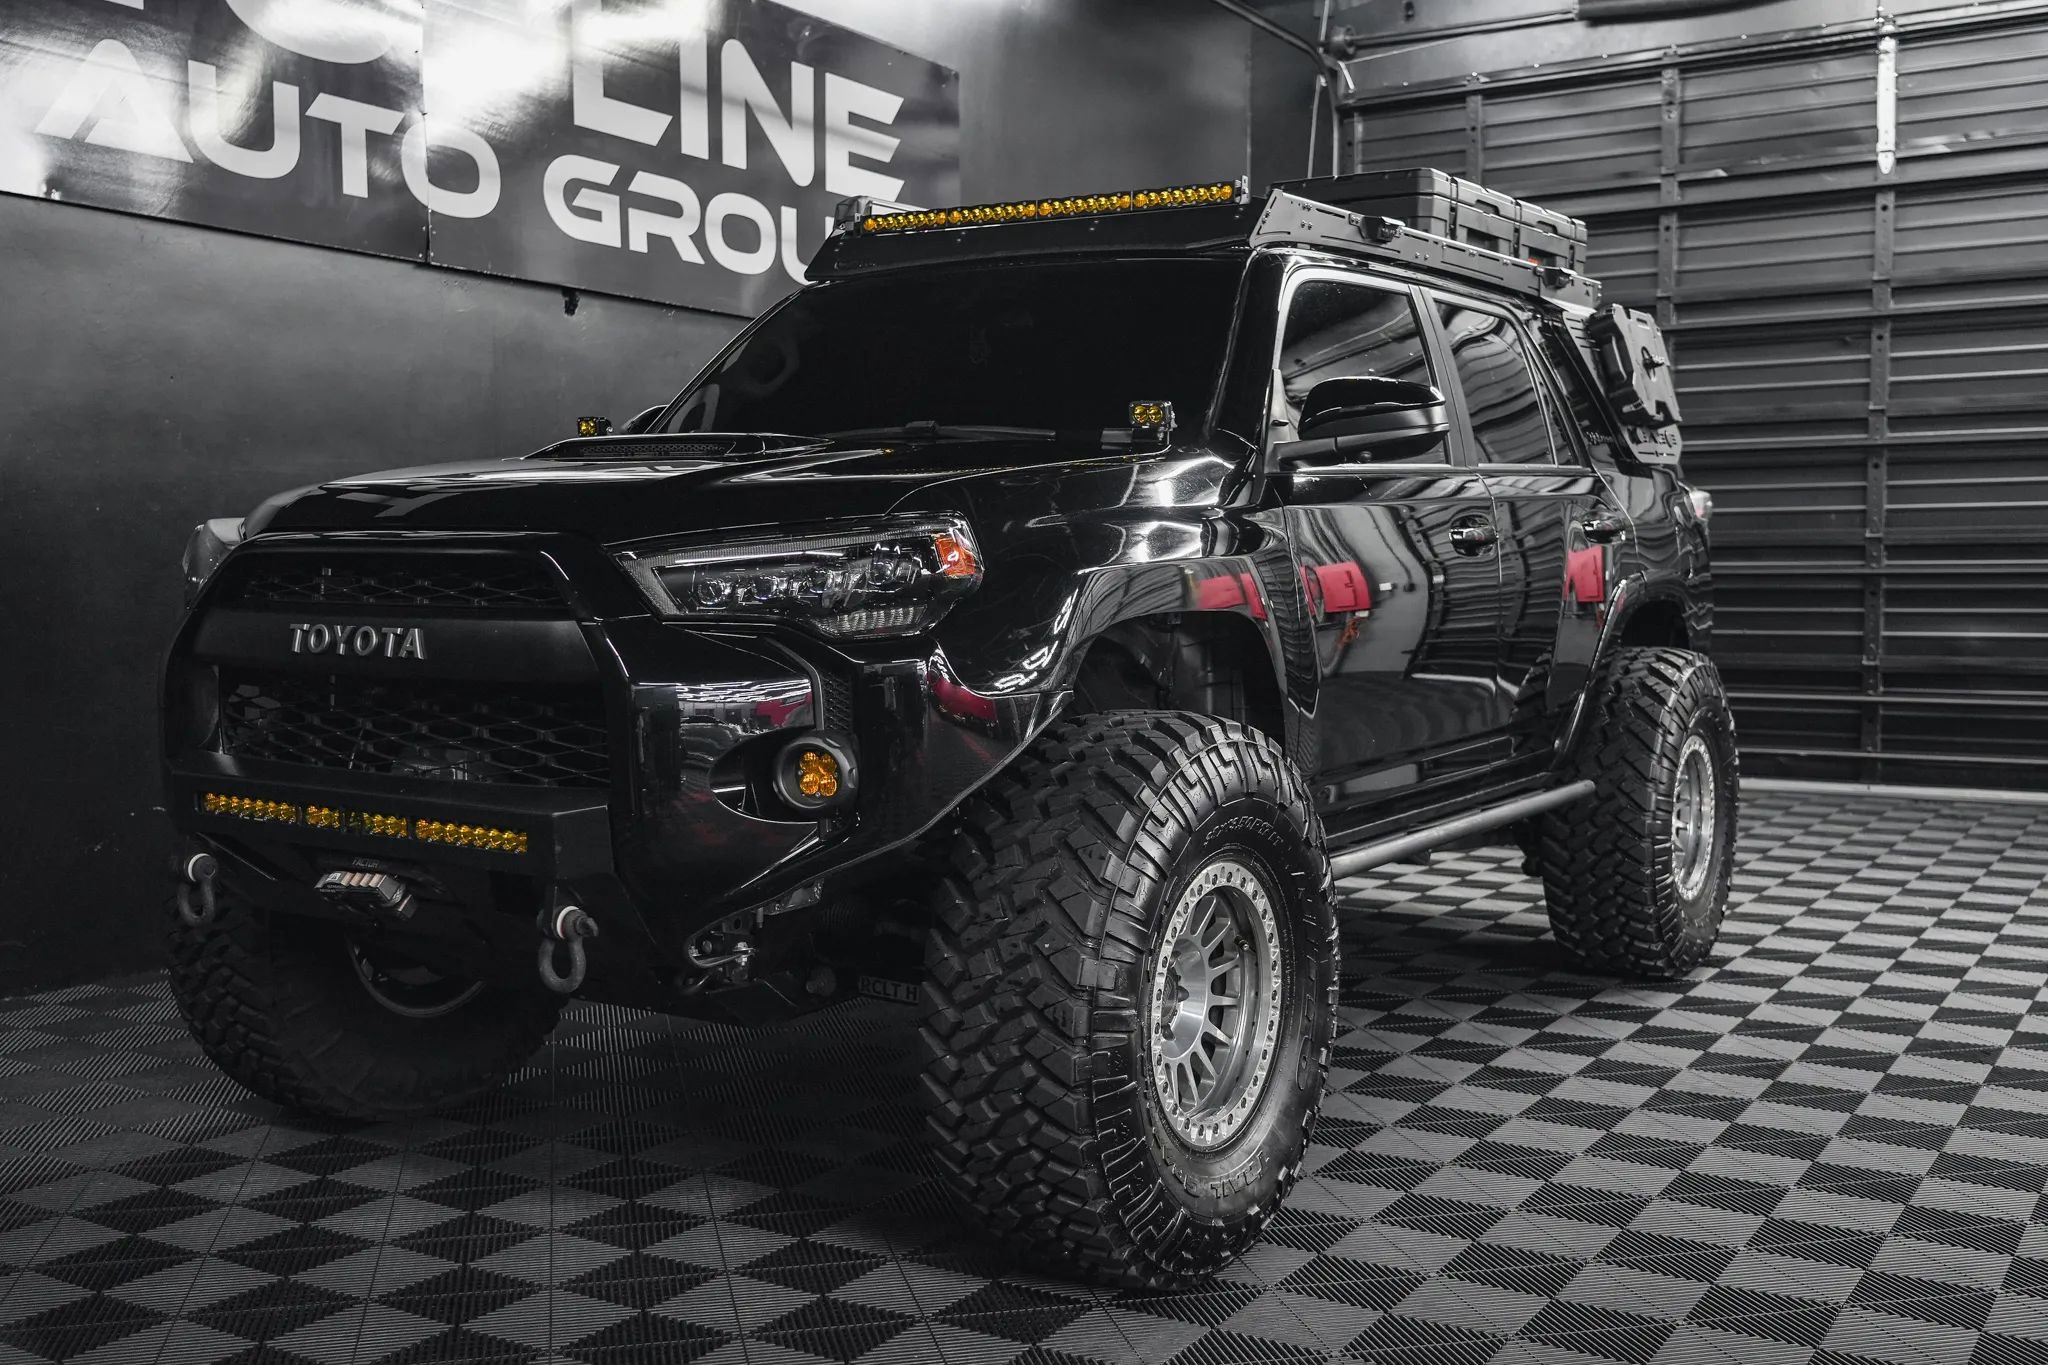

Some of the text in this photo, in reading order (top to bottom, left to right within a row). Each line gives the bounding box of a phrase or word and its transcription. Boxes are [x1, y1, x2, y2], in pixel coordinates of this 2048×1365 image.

[34, 38, 501, 218] AUTO
[572, 0, 905, 202] LINE
[289, 623, 427, 660] TOYOTA
